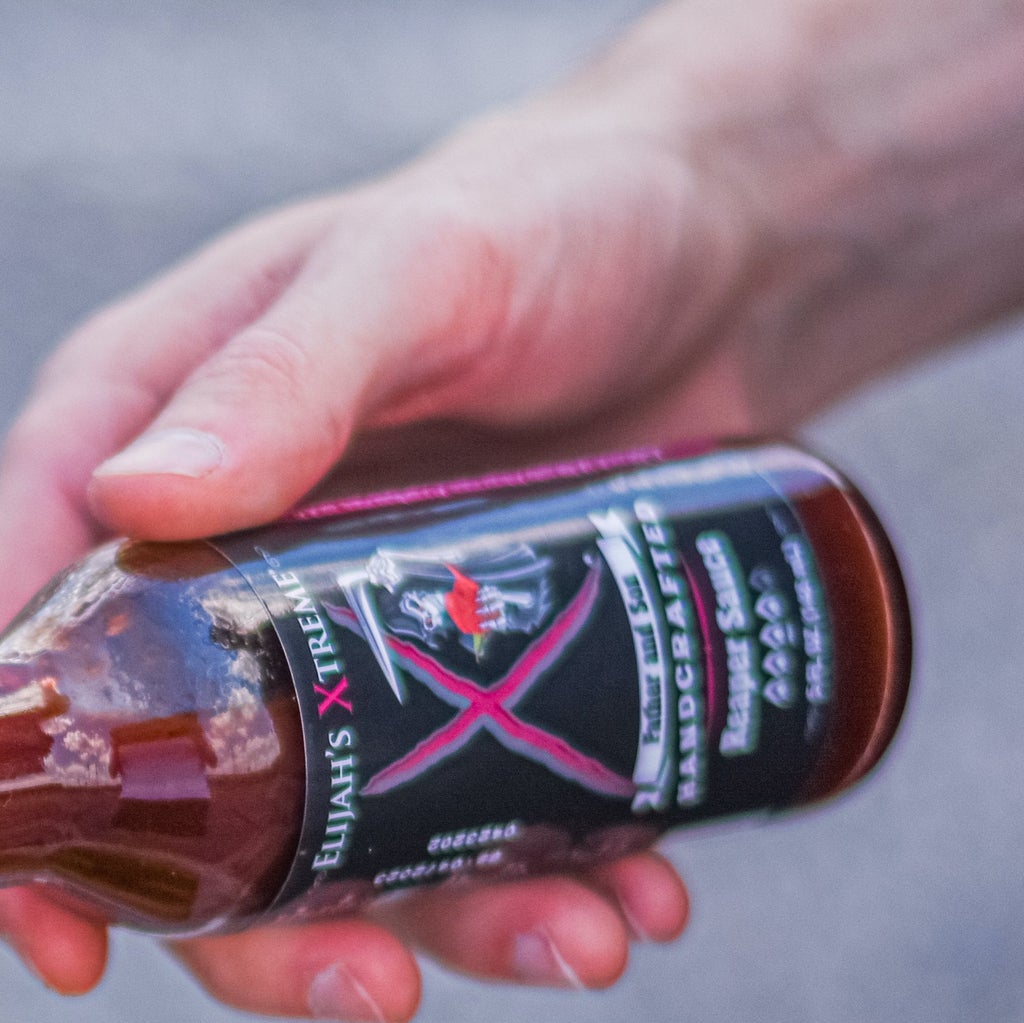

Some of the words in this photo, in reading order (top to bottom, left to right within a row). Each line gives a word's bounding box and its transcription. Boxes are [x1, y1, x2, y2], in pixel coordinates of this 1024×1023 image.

[623, 574, 648, 615] Son
[695, 537, 746, 634] Sauce
[634, 500, 698, 802] HANDCRAFTED
[635, 622, 658, 663] and
[642, 673, 661, 744] Father
[720, 638, 757, 750] Reaper
[312, 729, 355, 870] ELIJAH'S
